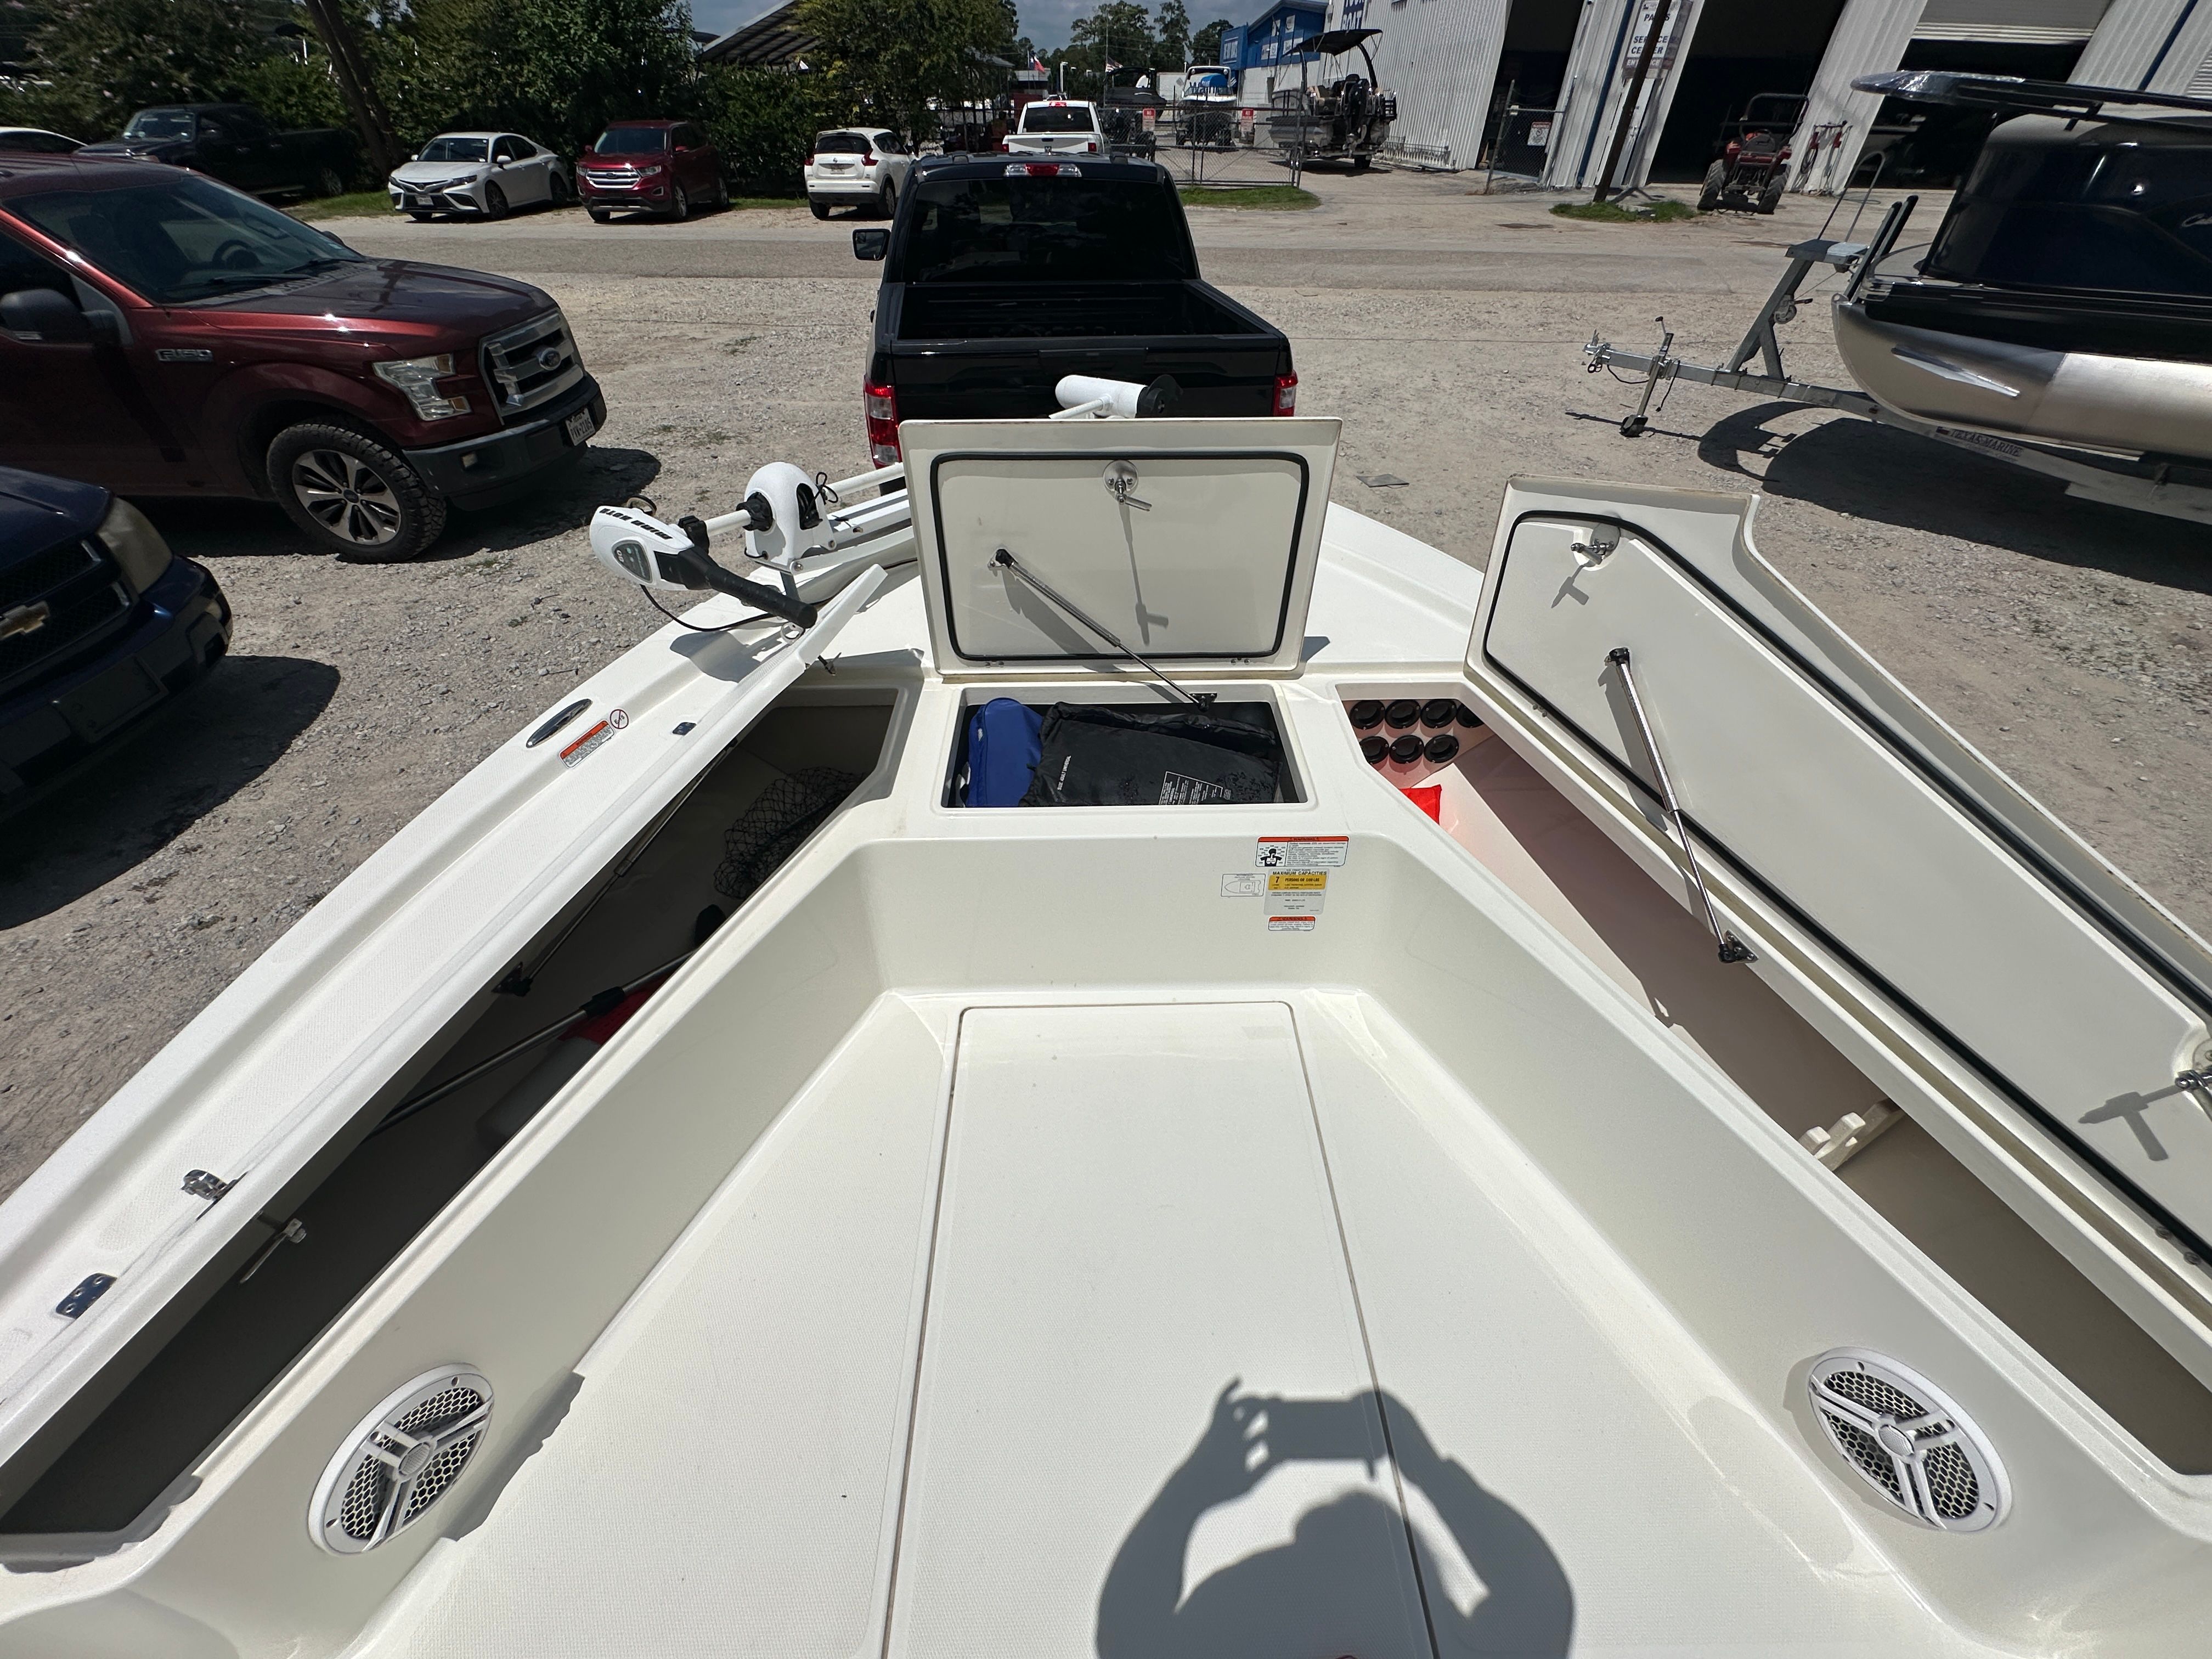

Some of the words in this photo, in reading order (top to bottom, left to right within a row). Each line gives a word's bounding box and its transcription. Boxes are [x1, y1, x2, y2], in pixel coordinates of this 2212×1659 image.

[1644, 13, 1671, 21] PAS
[1950, 429, 1982, 444] TEXAS
[1982, 438, 2023, 456] MARINE
